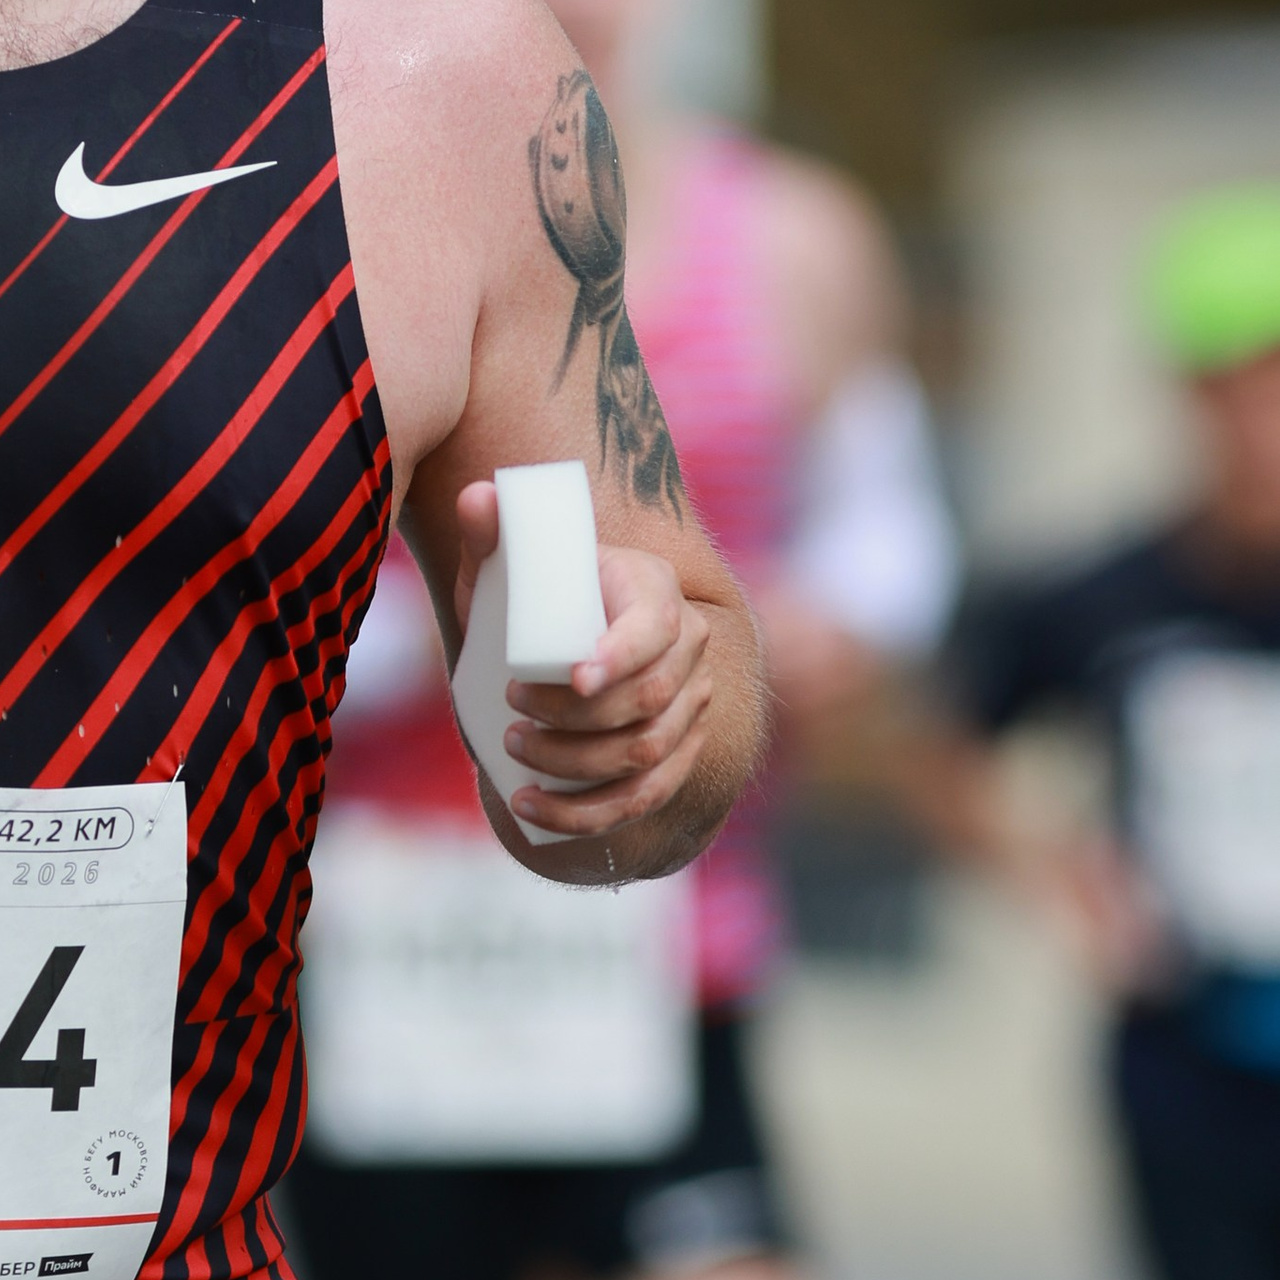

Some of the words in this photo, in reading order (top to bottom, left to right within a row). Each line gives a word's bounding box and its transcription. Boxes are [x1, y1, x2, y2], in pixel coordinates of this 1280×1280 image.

[12, 860, 100, 886] 2026
[83, 1135, 104, 1162] БЕГУ
[108, 1129, 148, 1189] МОСКОВСКИЙ
[105, 1150, 122, 1177] 1
[82, 1166, 127, 1198] МАРАФОН
[43, 1258, 83, 1272] Прайм
